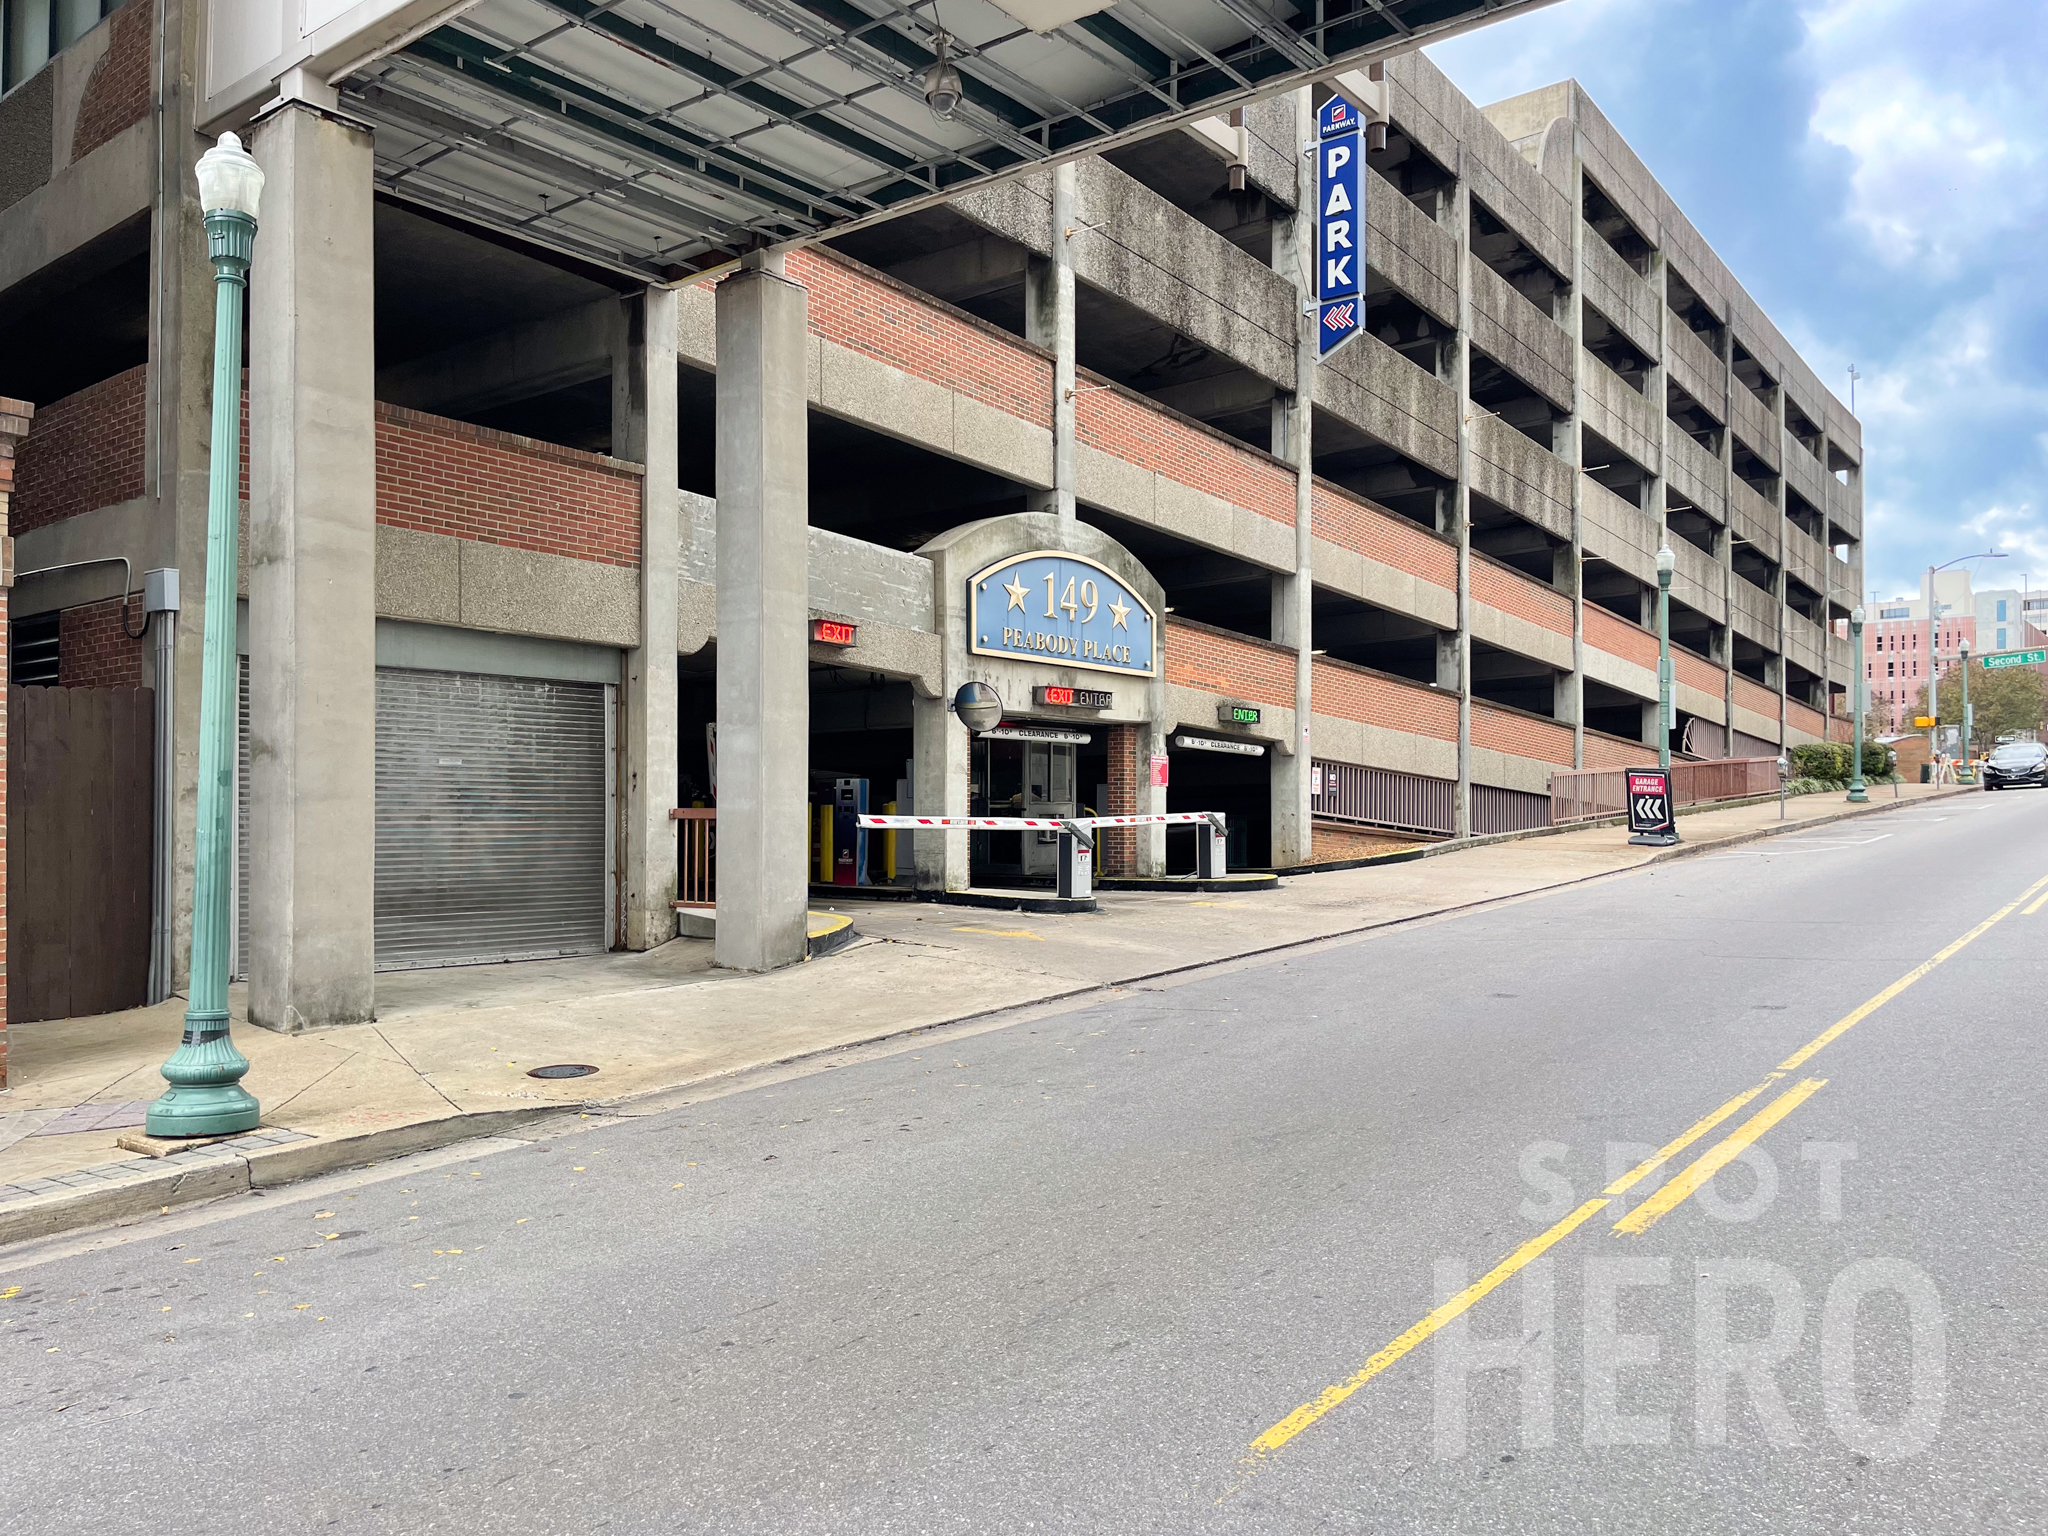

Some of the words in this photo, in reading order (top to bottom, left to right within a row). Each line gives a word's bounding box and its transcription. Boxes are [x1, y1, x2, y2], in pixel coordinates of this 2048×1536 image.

[1322, 117, 1355, 134] PARKWAY
[1325, 145, 1353, 289] PARK
[1043, 571, 1098, 624] 149
[822, 622, 855, 644] EXIT
[1002, 626, 1079, 656] PEABODY
[1083, 639, 1132, 664] PLACE
[1988, 654, 2022, 666] Second
[2027, 652, 2042, 662] St.
[1049, 688, 1075, 705] EXIT
[1080, 691, 1113, 707] ENTER
[1233, 708, 1258, 722] ENTER
[1018, 729, 1059, 739] CLEARANCE
[1210, 741, 1241, 751] CLEARANCE
[1632, 785, 1663, 793] ENTRANCE
[1635, 777, 1659, 786] GARAGE
